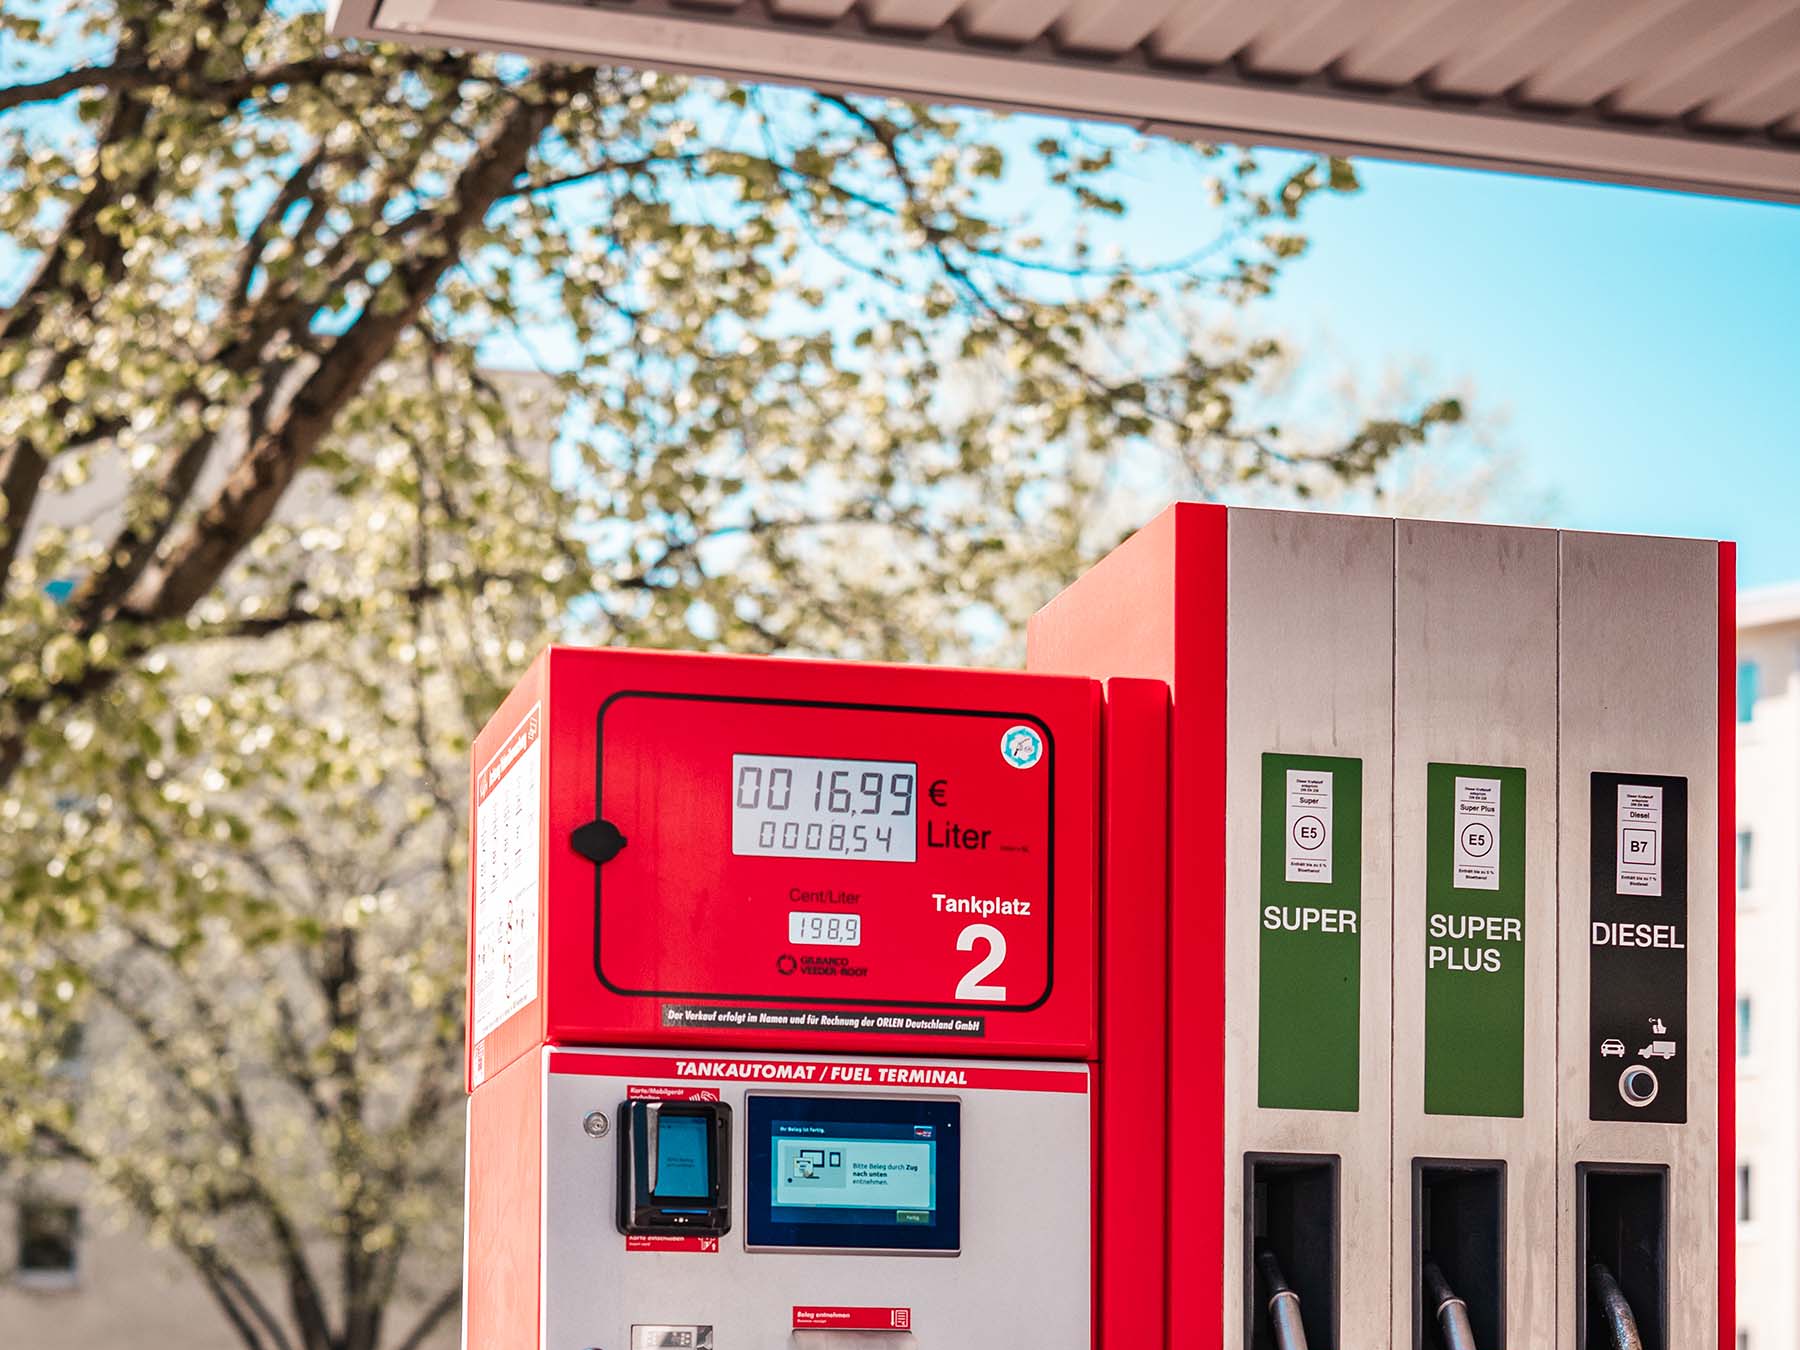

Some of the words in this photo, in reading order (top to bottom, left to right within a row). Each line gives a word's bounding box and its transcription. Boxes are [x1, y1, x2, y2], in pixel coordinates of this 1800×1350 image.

[928, 780, 948, 807] €
[1299, 796, 1320, 805] Super
[1460, 803, 1479, 812] Super
[1481, 805, 1495, 813] Plus
[1630, 811, 1650, 819] Diesel
[759, 821, 892, 855] 0008,54
[927, 820, 992, 850] Liter
[1301, 826, 1317, 839] E5
[1469, 833, 1485, 846] E5
[1631, 840, 1648, 853] B7
[789, 888, 861, 905] Cent/Liter
[932, 893, 1031, 918] Tankplatz
[800, 917, 857, 943] 198,9
[1263, 905, 1358, 934] SUPER
[1430, 913, 1522, 943] SUPER
[1592, 922, 1685, 950] DIESEL
[955, 923, 1007, 1001] 2
[1429, 946, 1501, 973] PLUS
[668, 1010, 683, 1020] Der
[684, 1010, 717, 1022] Verkauf
[717, 1012, 746, 1024] erfolgt
[747, 1012, 758, 1023] im
[759, 1013, 788, 1024] Namen
[789, 1014, 805, 1025] und
[806, 1014, 819, 1025] für
[820, 1015, 859, 1029] Rechnung
[860, 1016, 875, 1027] der
[876, 1017, 904, 1028] ORLEN
[905, 1018, 954, 1030] Deutschland
[955, 1020, 980, 1031] GmbH
[675, 1061, 816, 1080] TANKAUTOMAT
[819, 1064, 828, 1081] /
[830, 1066, 872, 1082] FUEL
[878, 1068, 967, 1085] TERMINAL
[852, 1162, 867, 1170] Bitte
[869, 1163, 887, 1172] Beleg
[888, 1163, 905, 1171] durch
[905, 1164, 918, 1172] Zug
[797, 1311, 814, 1320] Beleg
